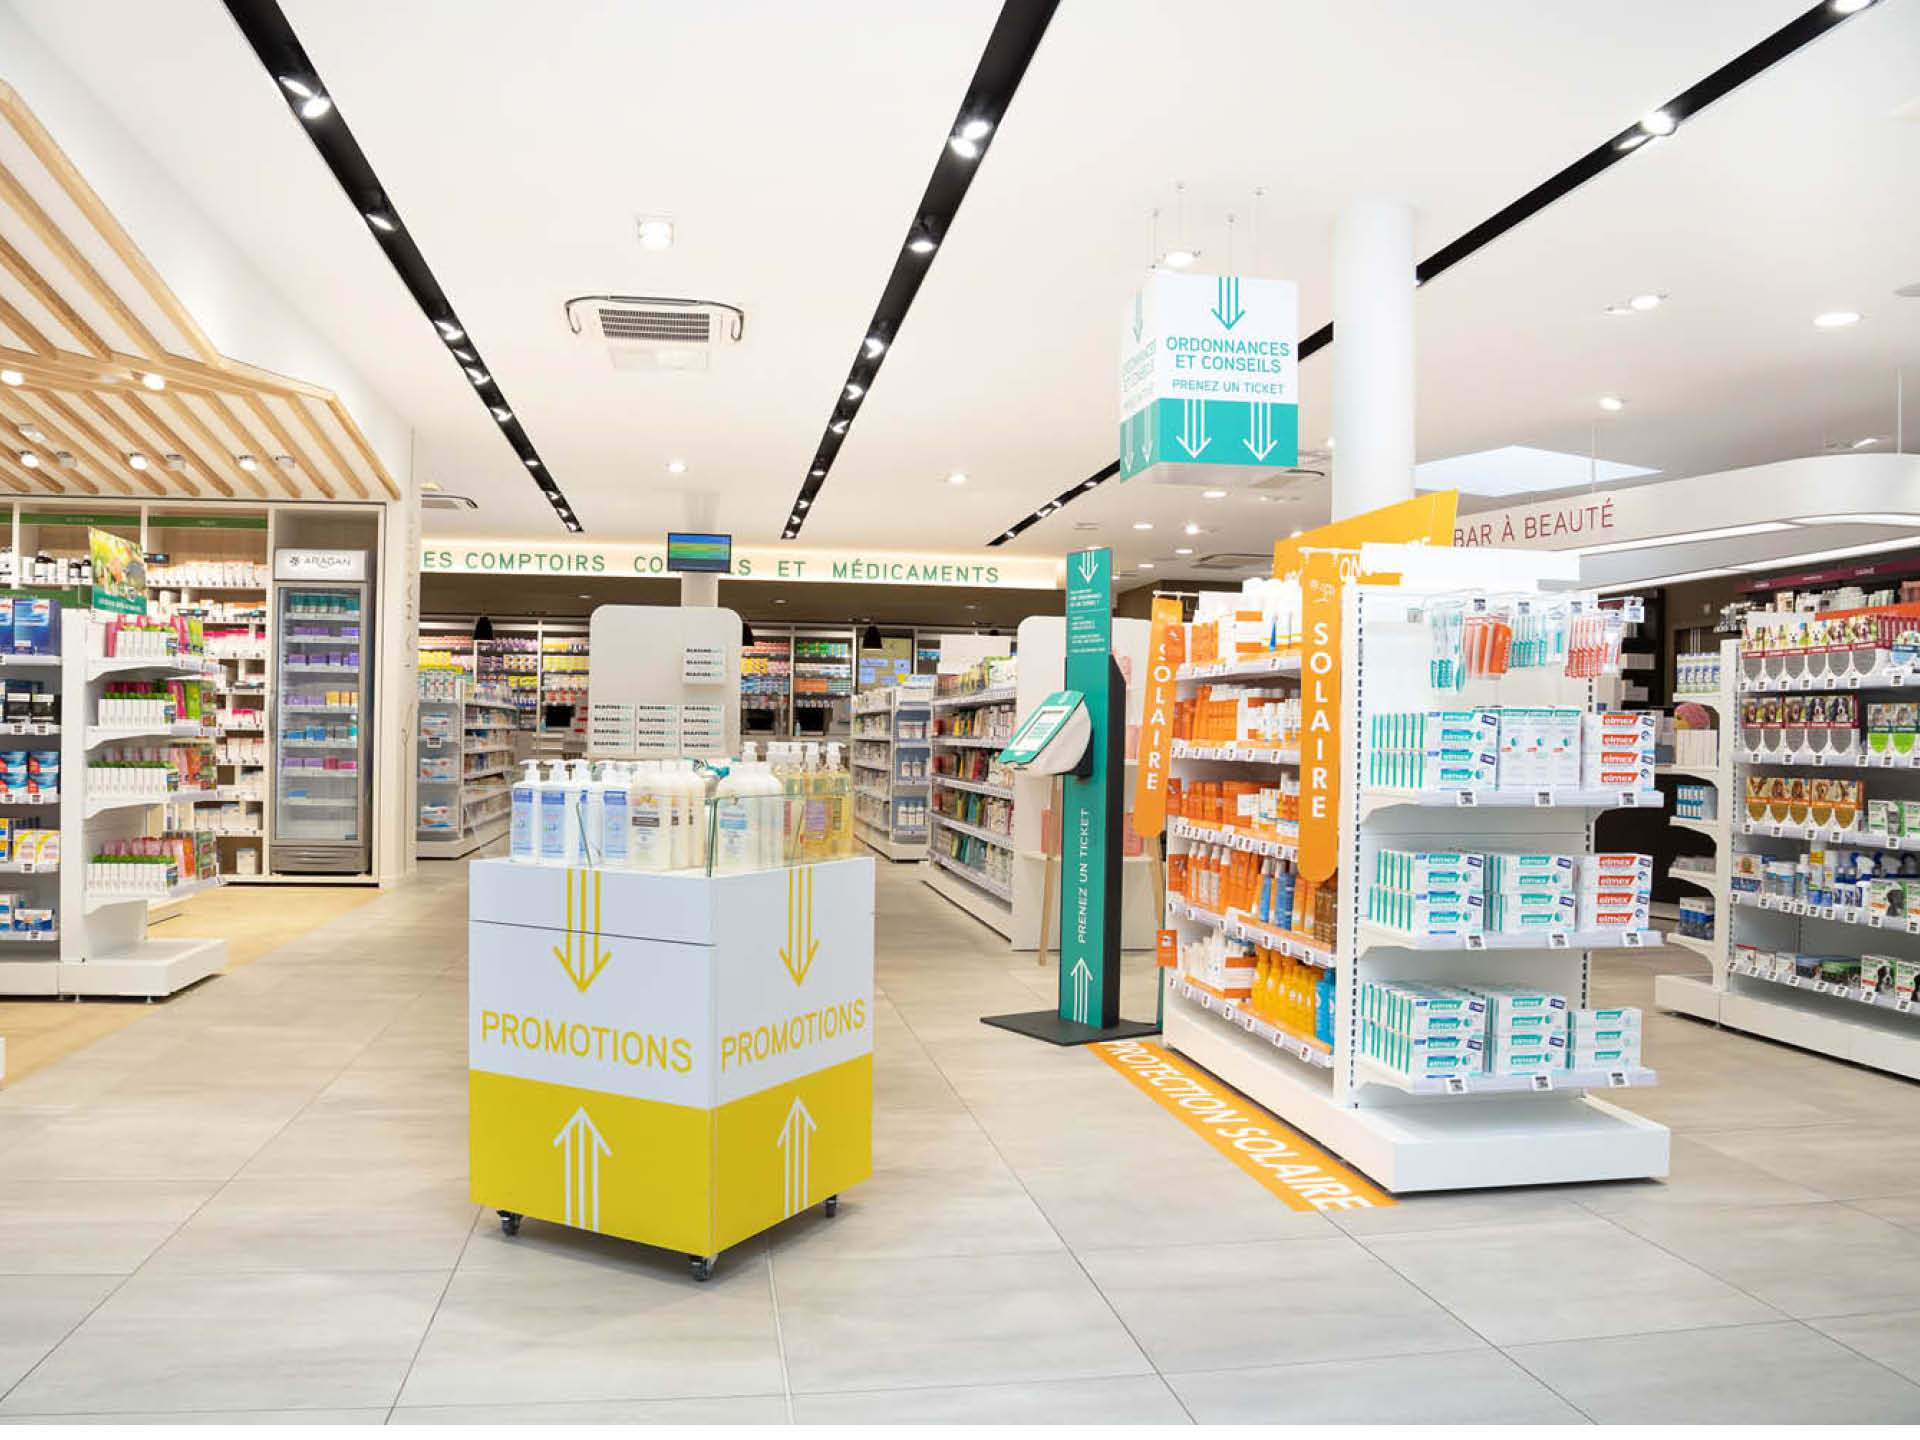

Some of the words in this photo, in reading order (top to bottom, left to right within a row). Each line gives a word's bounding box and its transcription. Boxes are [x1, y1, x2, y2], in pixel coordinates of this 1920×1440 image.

[1166, 336, 1290, 357] ORDONNANCES
[1176, 354, 1194, 369] ET
[1201, 355, 1281, 373] CONSEILS
[1172, 379, 1219, 392] PRENEZ
[1223, 381, 1240, 393] UN
[1244, 383, 1284, 394] TICKET
[1454, 524, 1492, 547] BAR
[1501, 514, 1515, 541] À
[1525, 498, 1614, 539] BEAUTÉ
[465, 552, 605, 572] COMPTOIRS
[778, 561, 806, 577] ET
[832, 558, 999, 583] MÉDICAMENTS
[1309, 622, 1333, 817] SOLAIRE
[1604, 718, 1634, 726] elmex
[1603, 737, 1634, 745] elmex
[1603, 756, 1634, 764] elmex
[1079, 808, 1090, 857] TICKET
[1079, 863, 1088, 883] UN
[1077, 887, 1088, 944] PRENEZ
[480, 1010, 693, 1073] PROMOTIONS
[721, 999, 866, 1072] PROMOTIONS
[1099, 1041, 1249, 1123] PROTECTION
[1216, 1121, 1373, 1212] SOLAIRE
